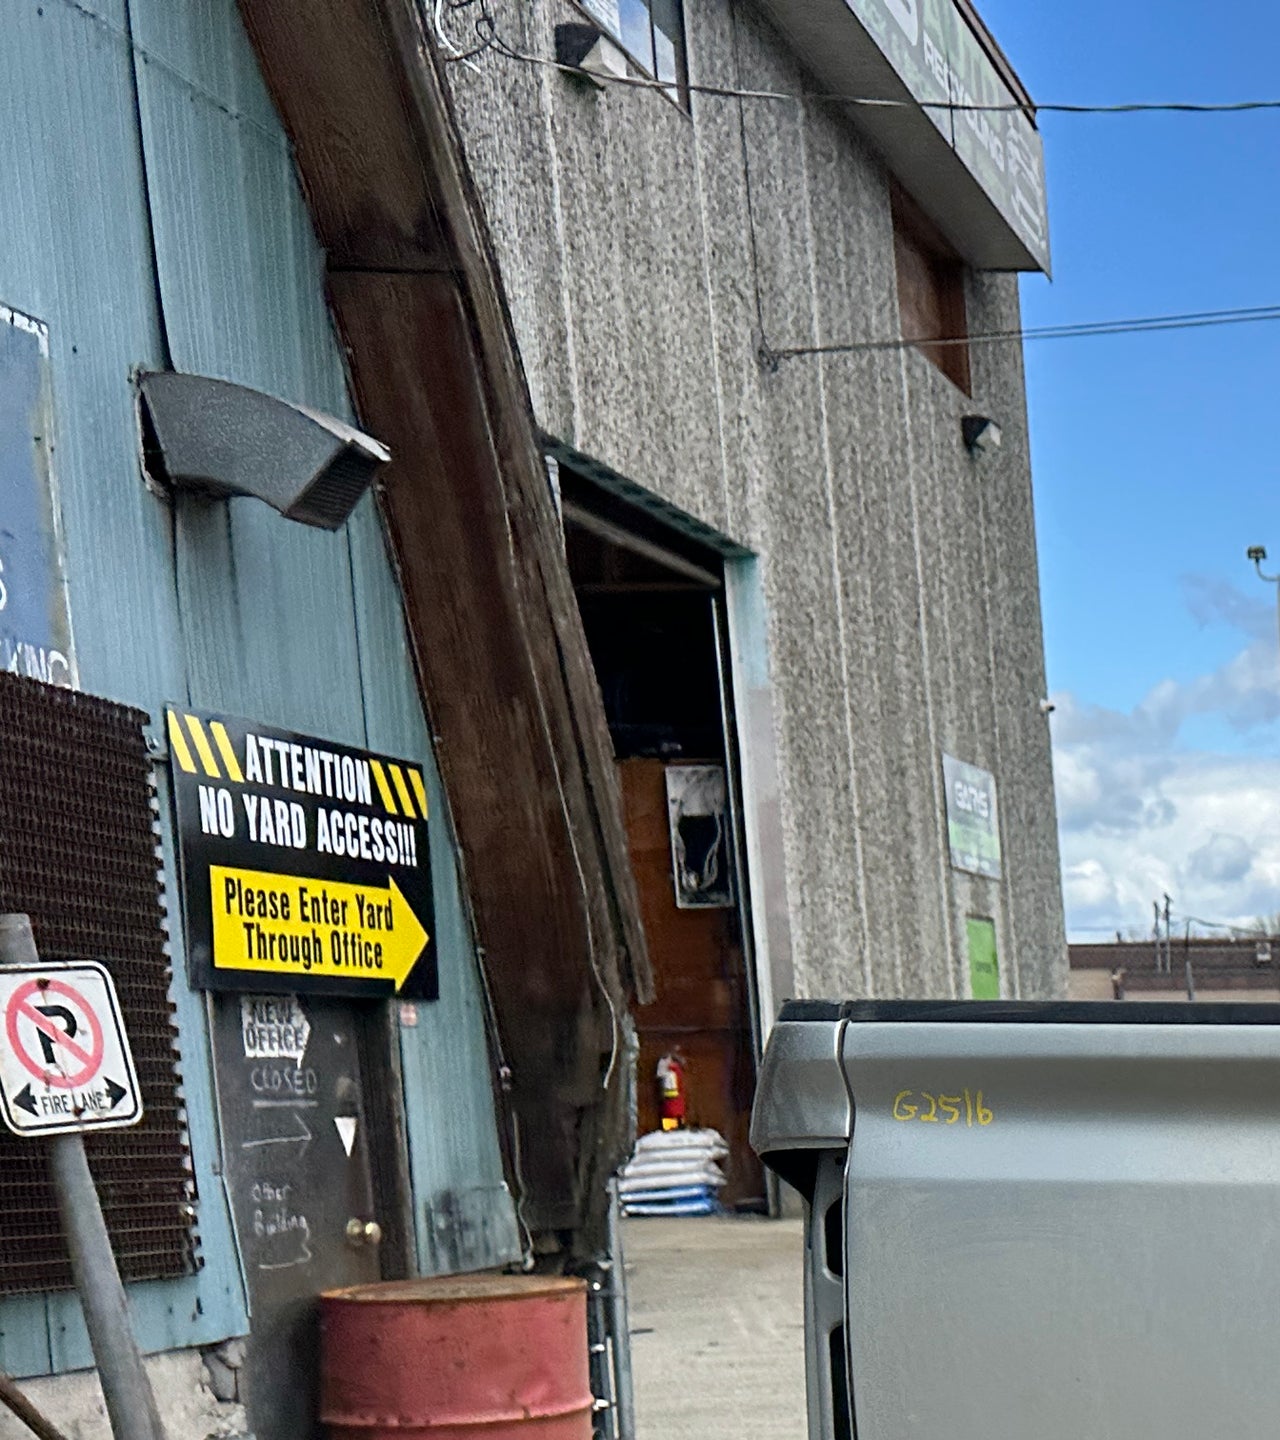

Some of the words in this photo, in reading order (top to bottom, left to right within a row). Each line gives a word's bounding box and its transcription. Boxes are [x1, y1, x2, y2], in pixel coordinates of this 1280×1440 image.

[0, 638, 71, 689] KING
[245, 733, 372, 806] ATTENTION
[199, 785, 234, 839] NO
[242, 793, 306, 849] YARD
[317, 807, 417, 867] ACCESS!!!
[224, 876, 290, 920] Please
[299, 886, 348, 926] Enter
[356, 893, 393, 931] Yard
[244, 922, 323, 970] Through
[331, 930, 383, 969] Office
[41, 1094, 71, 1115] FIRE
[893, 1087, 993, 1128] G2516
